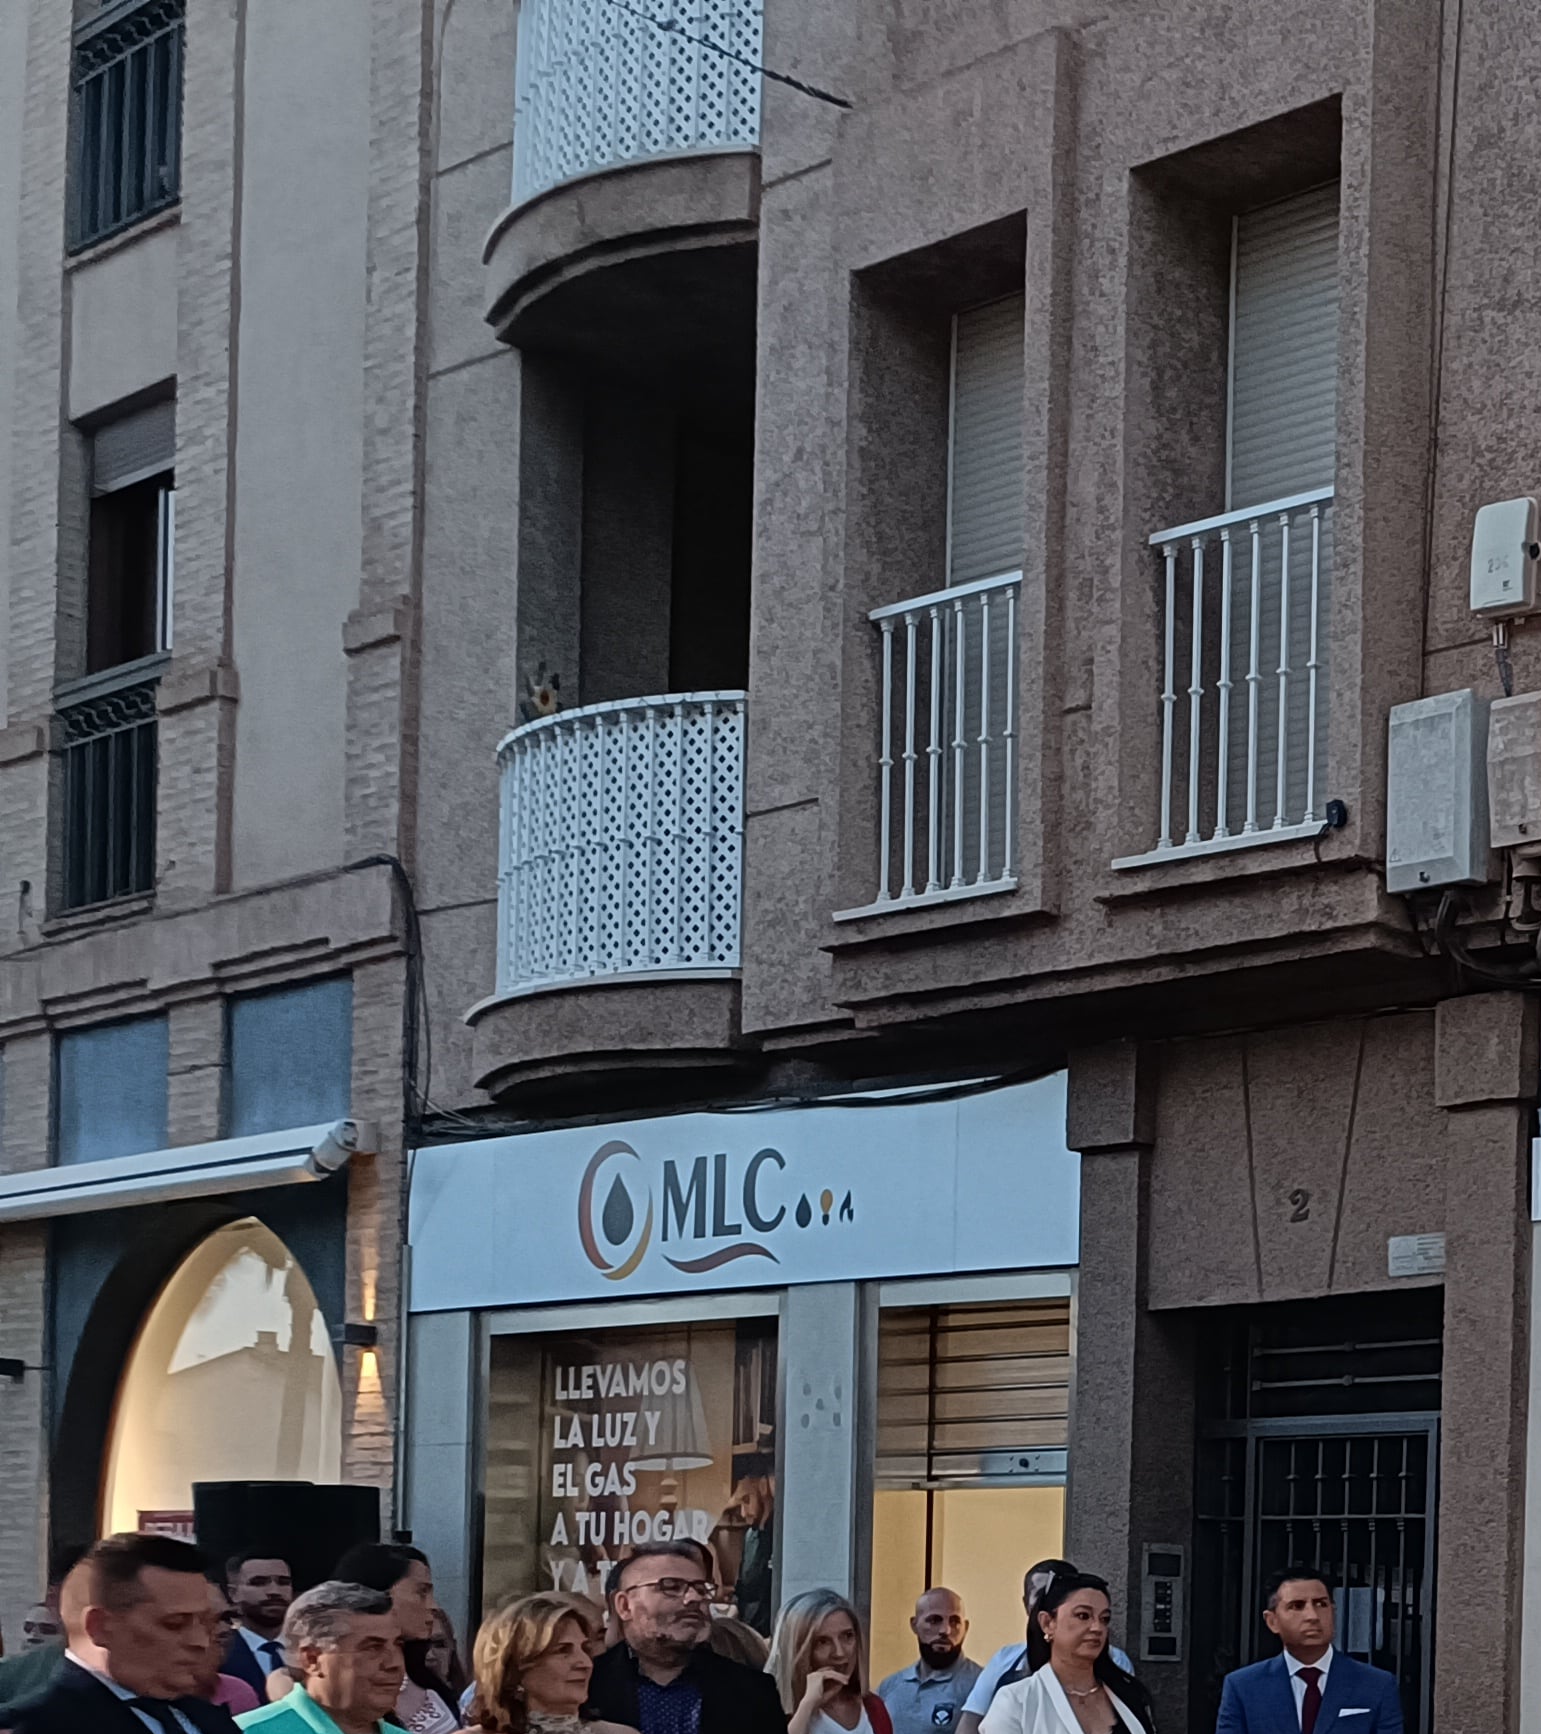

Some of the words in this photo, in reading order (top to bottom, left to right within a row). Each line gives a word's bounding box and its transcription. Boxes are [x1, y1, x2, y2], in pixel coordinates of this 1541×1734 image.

[661, 1147, 787, 1242] MLC
[1288, 1188, 1312, 1223] 2
[555, 1359, 687, 1400] LLEVAMOS
[553, 1413, 584, 1449] LA
[591, 1412, 637, 1448] LUZ
[644, 1410, 662, 1446] Y
[552, 1463, 579, 1498] EL
[585, 1461, 637, 1497] GAS
[550, 1512, 569, 1546] A
[575, 1510, 605, 1546] TU
[613, 1509, 710, 1545] HOGAR
[549, 1560, 565, 1592] Y
[571, 1559, 589, 1594] A
